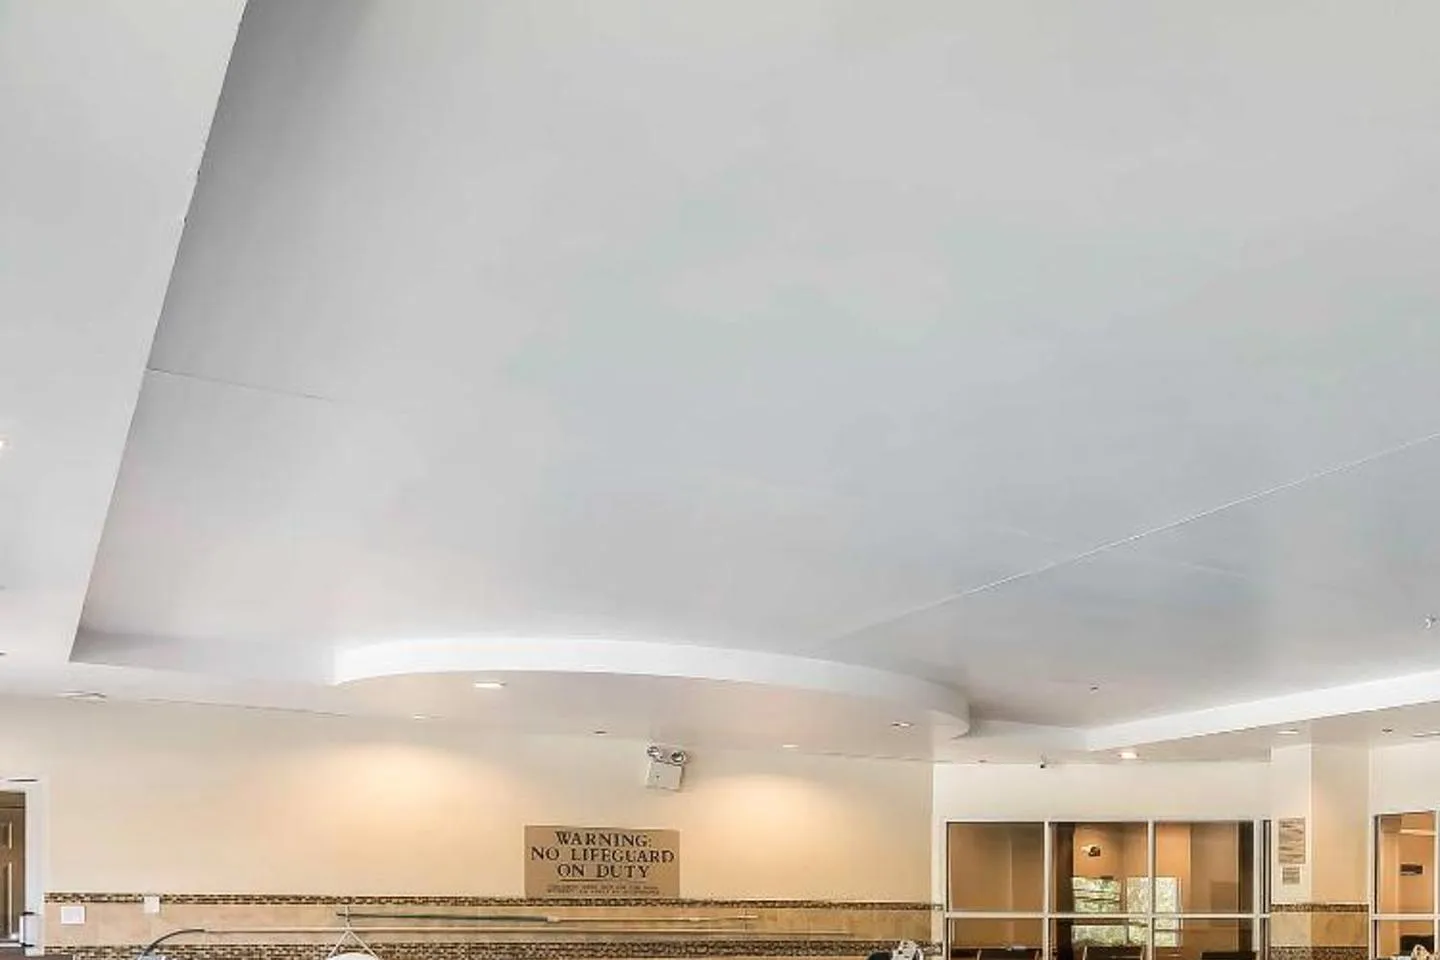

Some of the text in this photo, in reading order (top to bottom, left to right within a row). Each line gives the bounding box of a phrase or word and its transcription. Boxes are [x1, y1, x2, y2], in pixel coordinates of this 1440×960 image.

[531, 847, 675, 863] NO LIFEGUARD
[557, 864, 650, 878] ON DUTY
